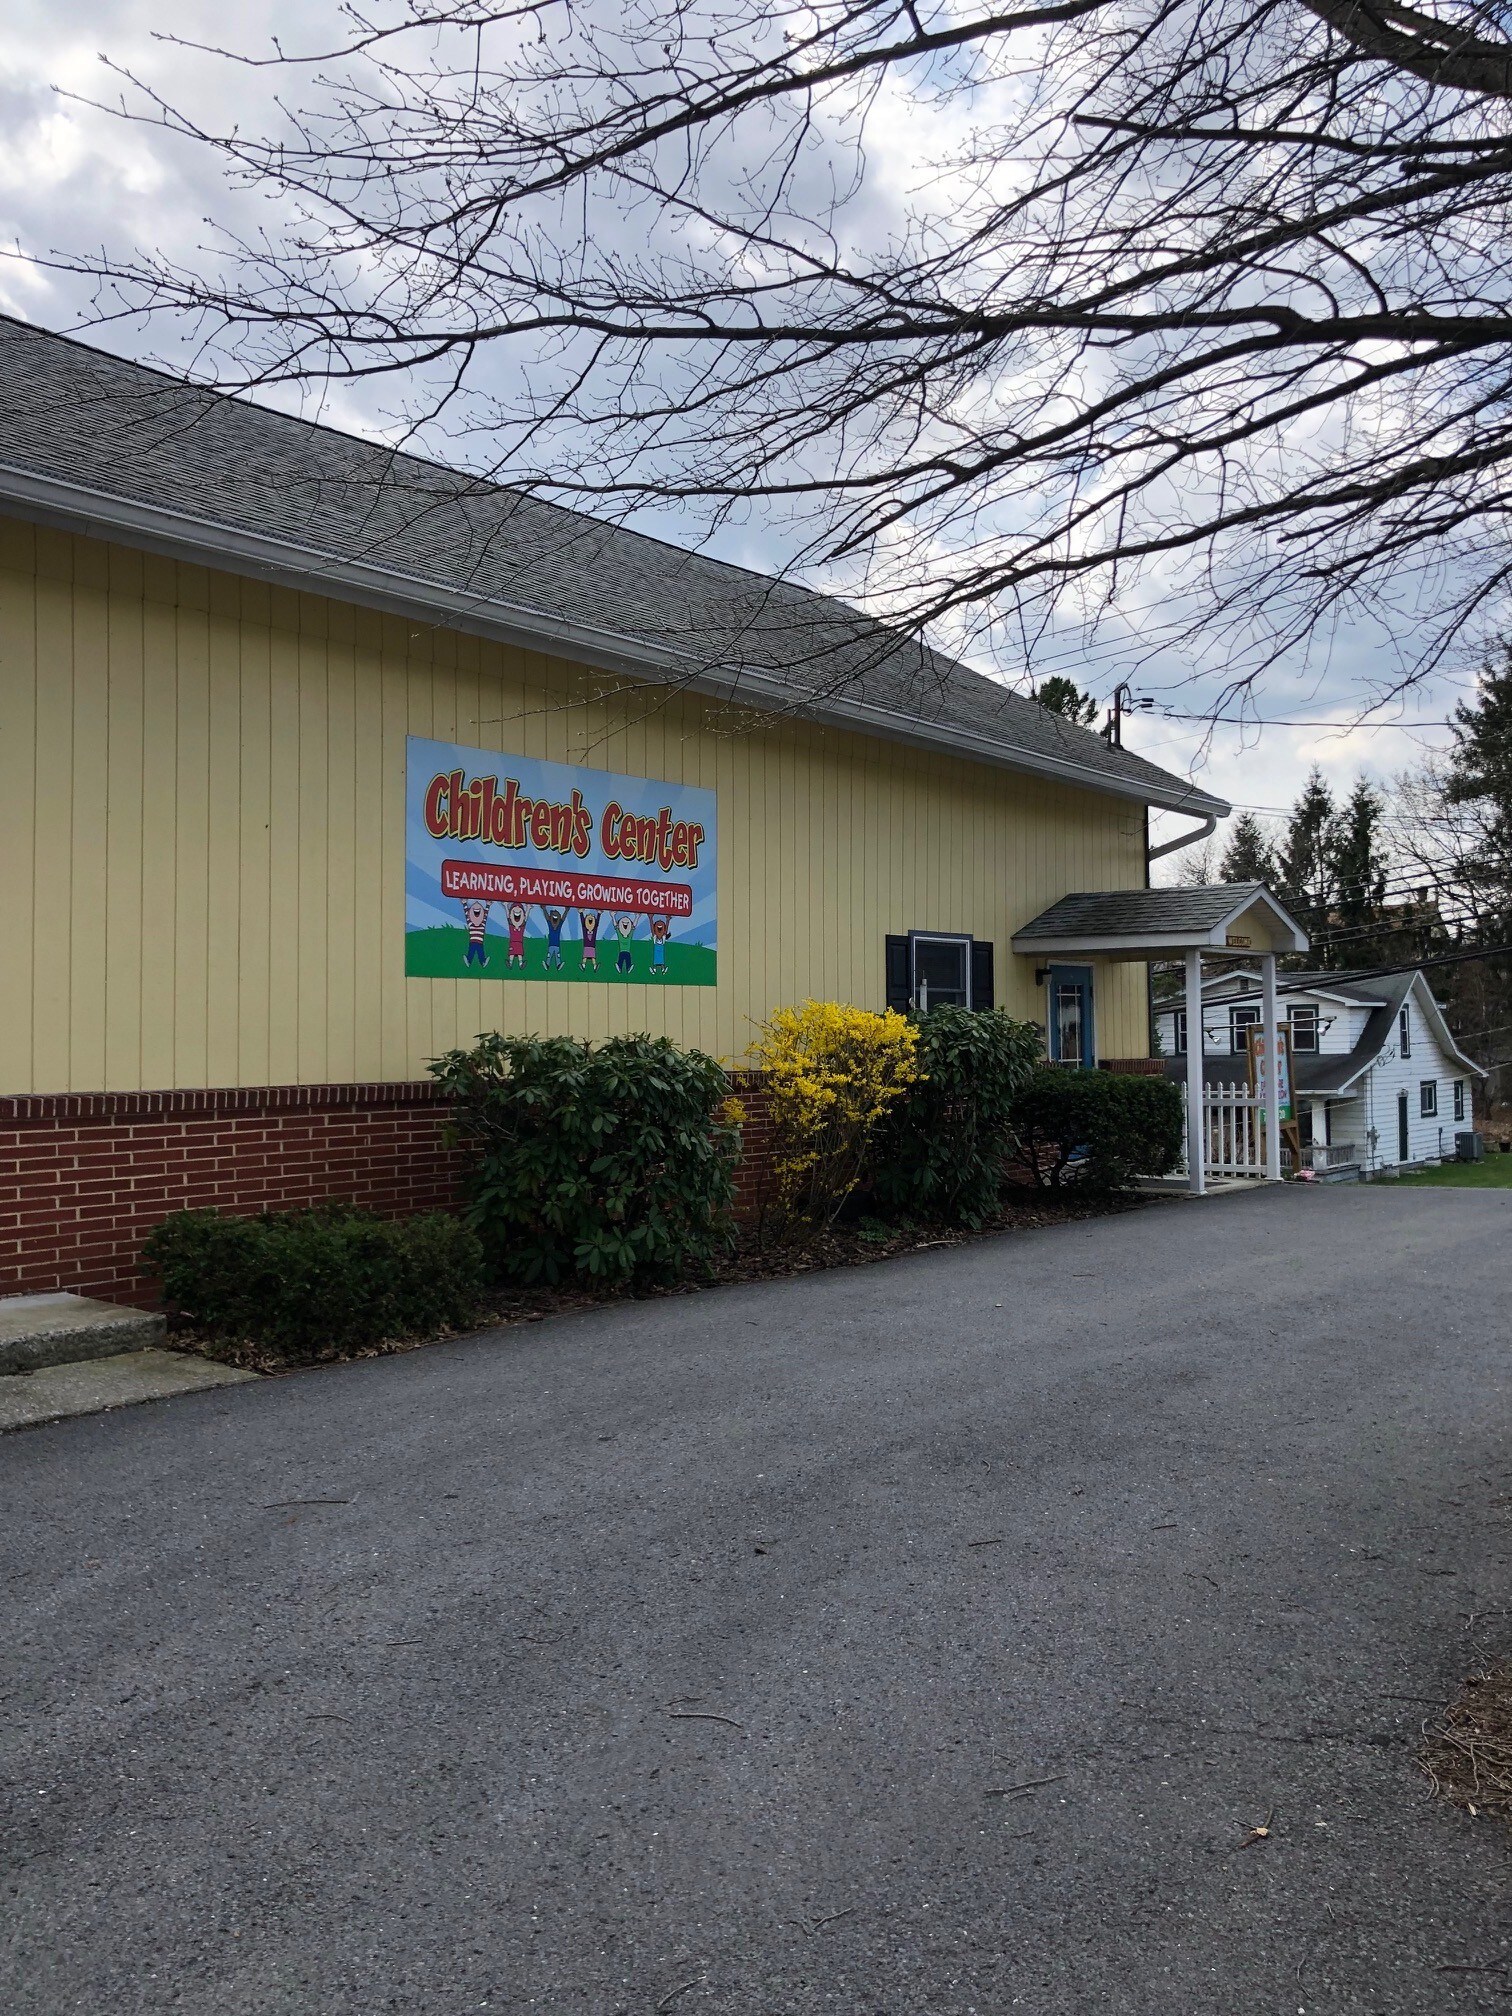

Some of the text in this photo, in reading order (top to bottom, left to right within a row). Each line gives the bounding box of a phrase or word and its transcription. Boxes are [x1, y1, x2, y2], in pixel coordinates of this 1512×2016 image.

[424, 768, 705, 873] Children's Center
[445, 870, 690, 910] LEARNING, PLAYING, GROWING TOGETHER
